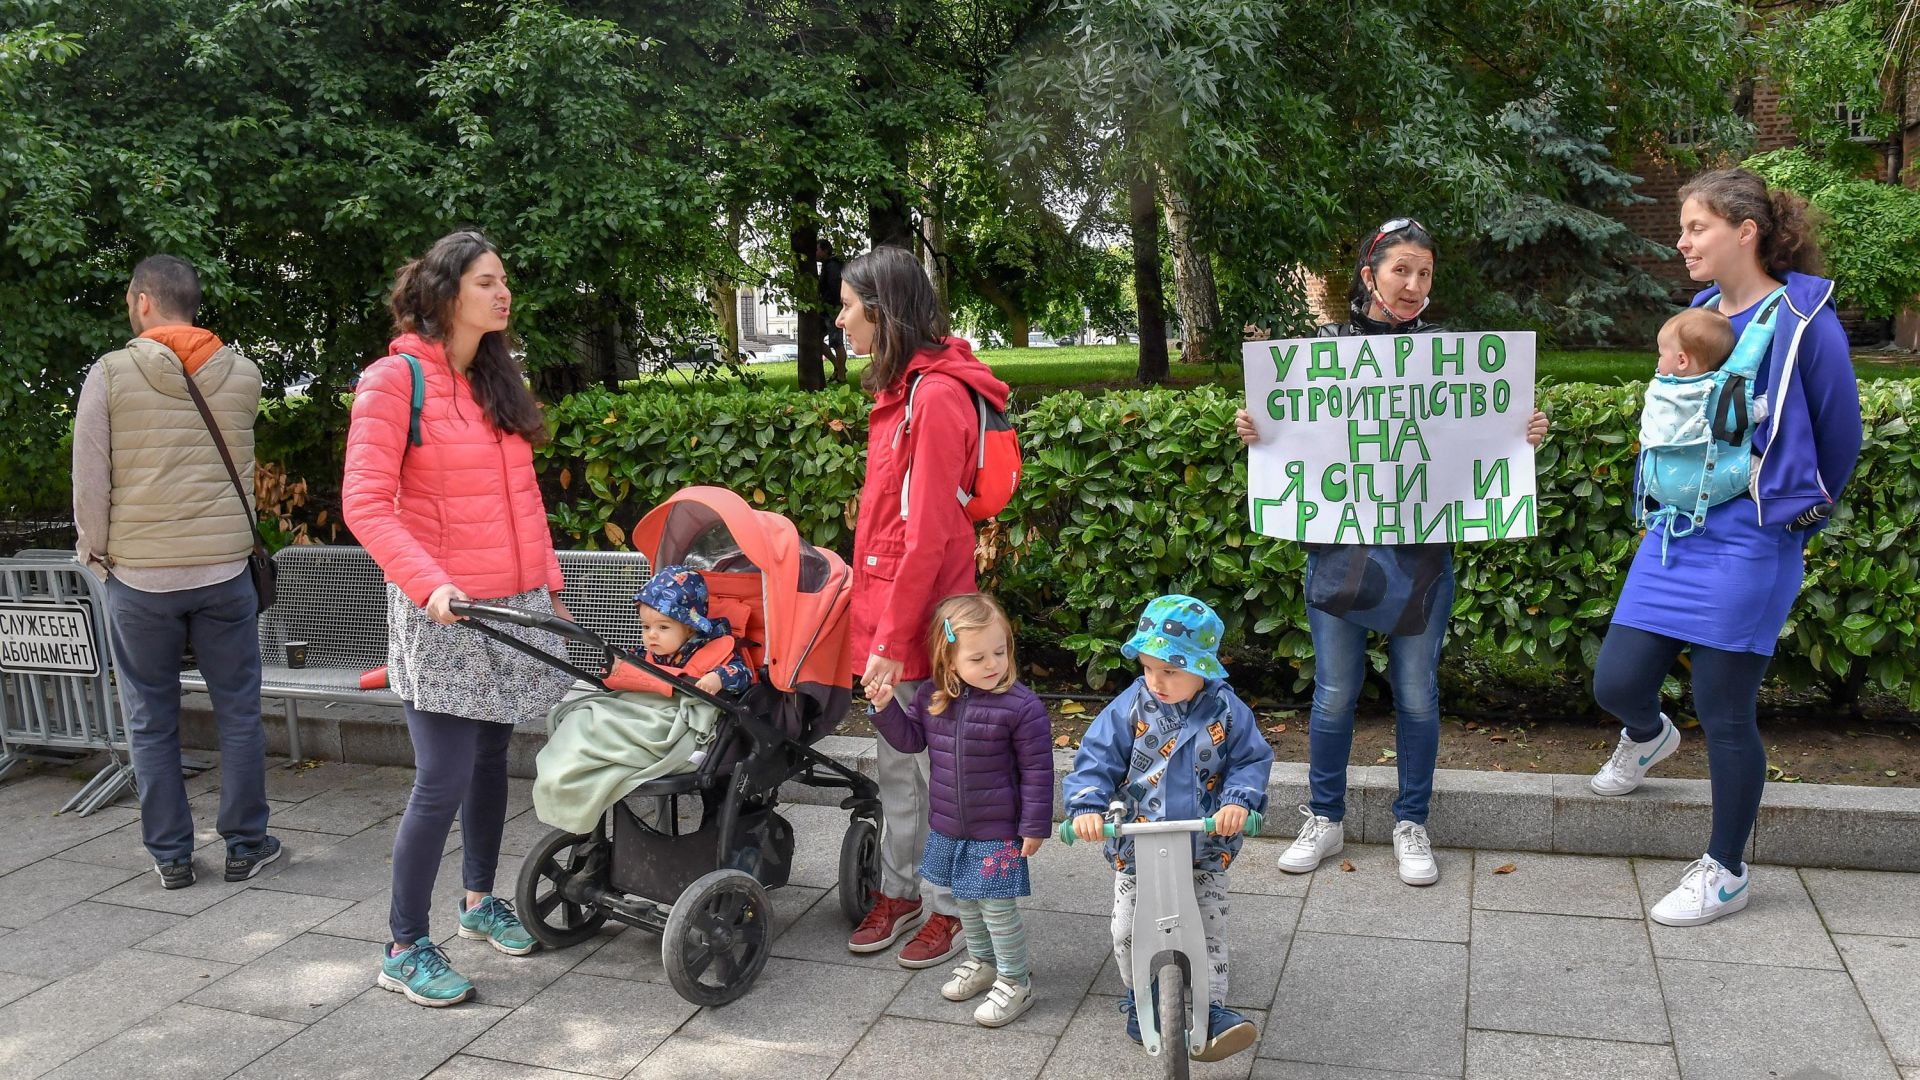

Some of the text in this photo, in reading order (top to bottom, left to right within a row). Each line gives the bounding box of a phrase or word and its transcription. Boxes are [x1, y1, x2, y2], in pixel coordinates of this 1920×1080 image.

[1269, 334, 1506, 382] УДАРНО
[1347, 419, 1431, 462] НА
[1473, 458, 1510, 500] И
[1254, 495, 1536, 544] ГРАДИНИ
[0, 614, 79, 637] СЛУЖЕБЕН
[2, 641, 89, 666] АБОНАМЕНТ
